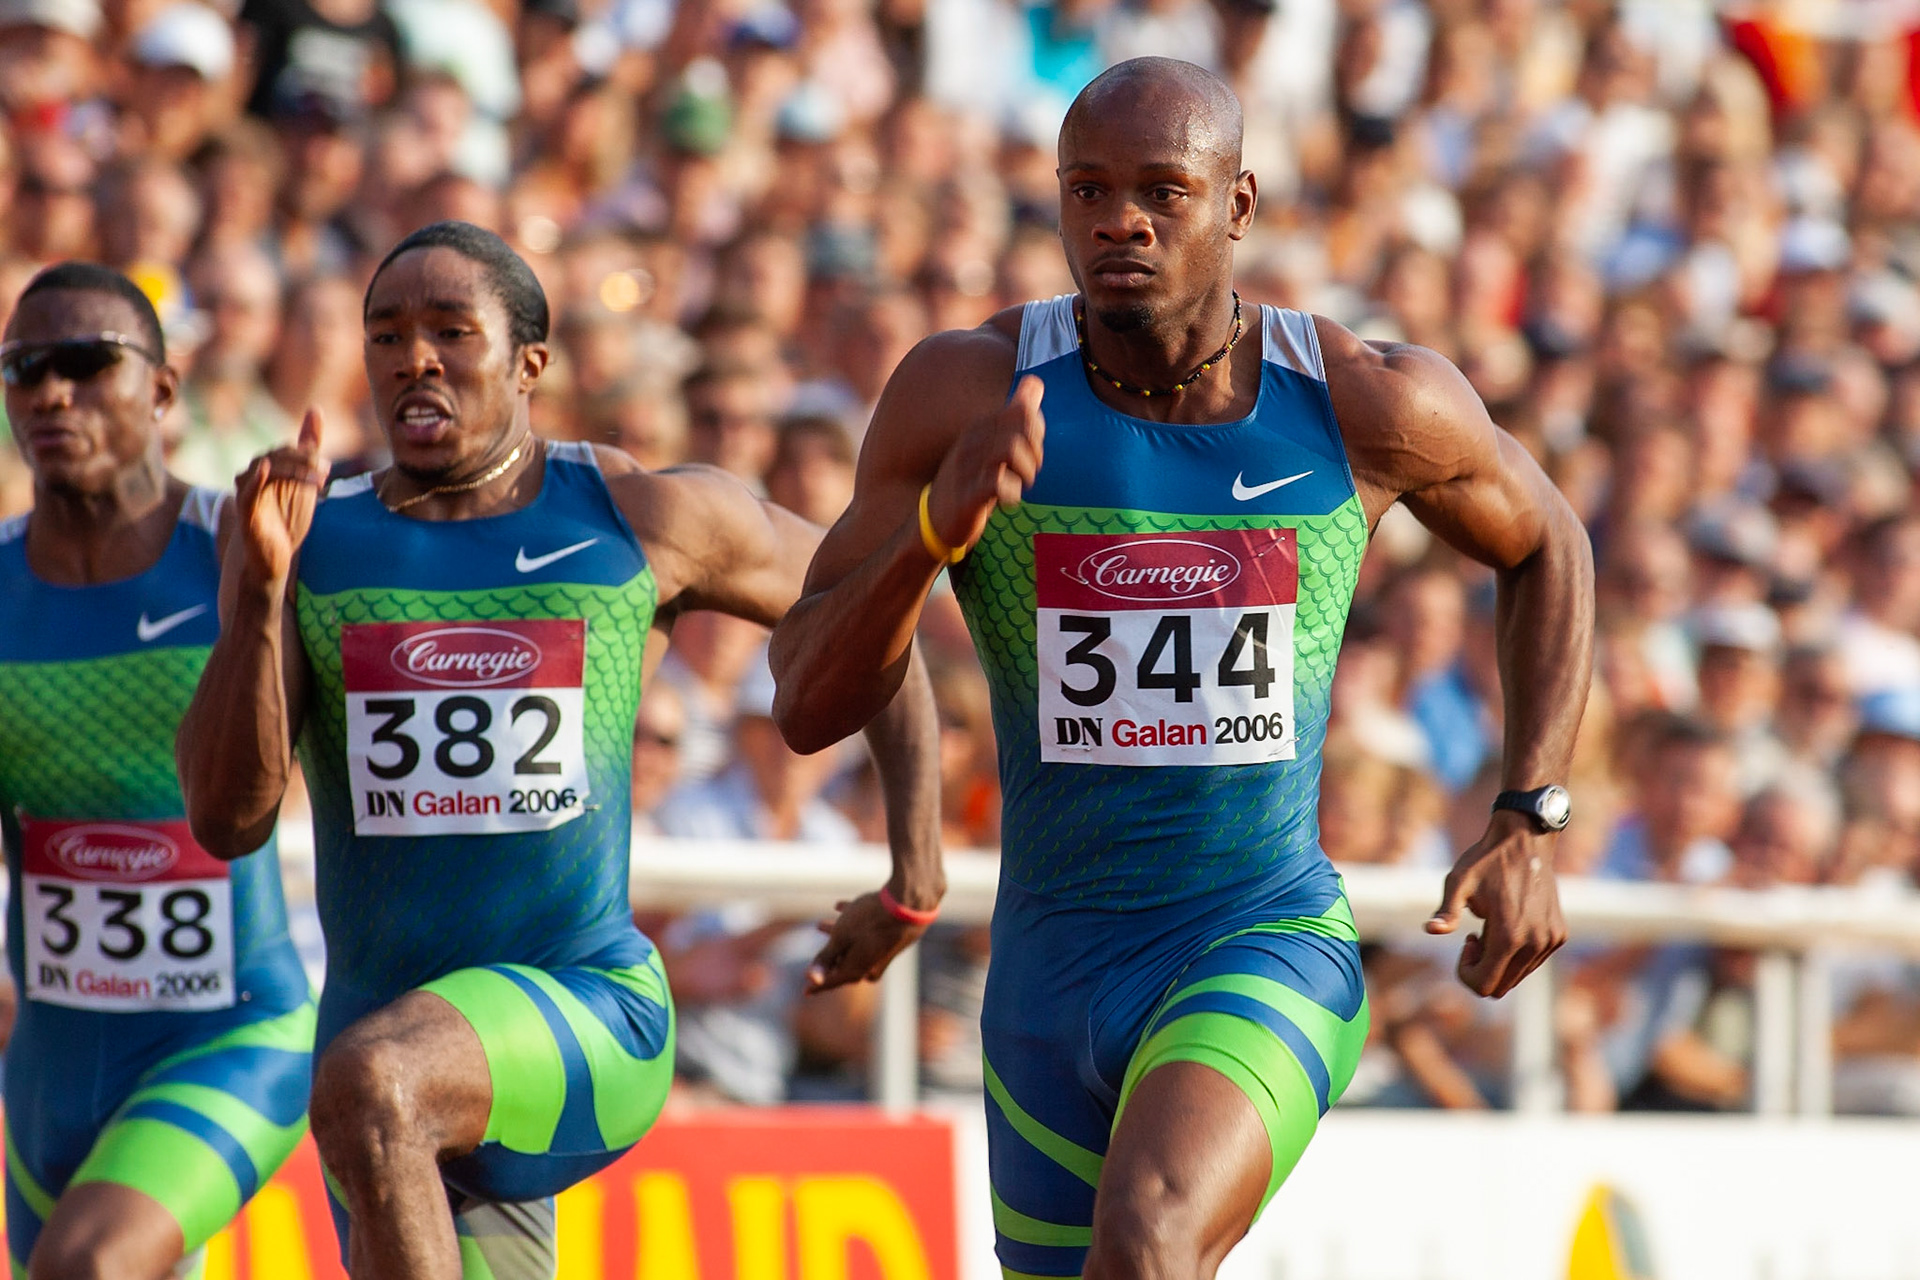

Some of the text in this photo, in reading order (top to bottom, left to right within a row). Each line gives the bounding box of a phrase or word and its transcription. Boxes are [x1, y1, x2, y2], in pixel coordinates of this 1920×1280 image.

[1090, 554, 1231, 594] Carnegie
[403, 640, 532, 680] Carnegie
[1059, 612, 1276, 707] 344
[364, 695, 562, 781] 382
[1054, 712, 1284, 747] DN Galan 2006
[366, 788, 578, 817] DN Galan 2006
[38, 884, 213, 962] 338
[75, 969, 151, 997] Galan
[157, 971, 221, 998] 2006
